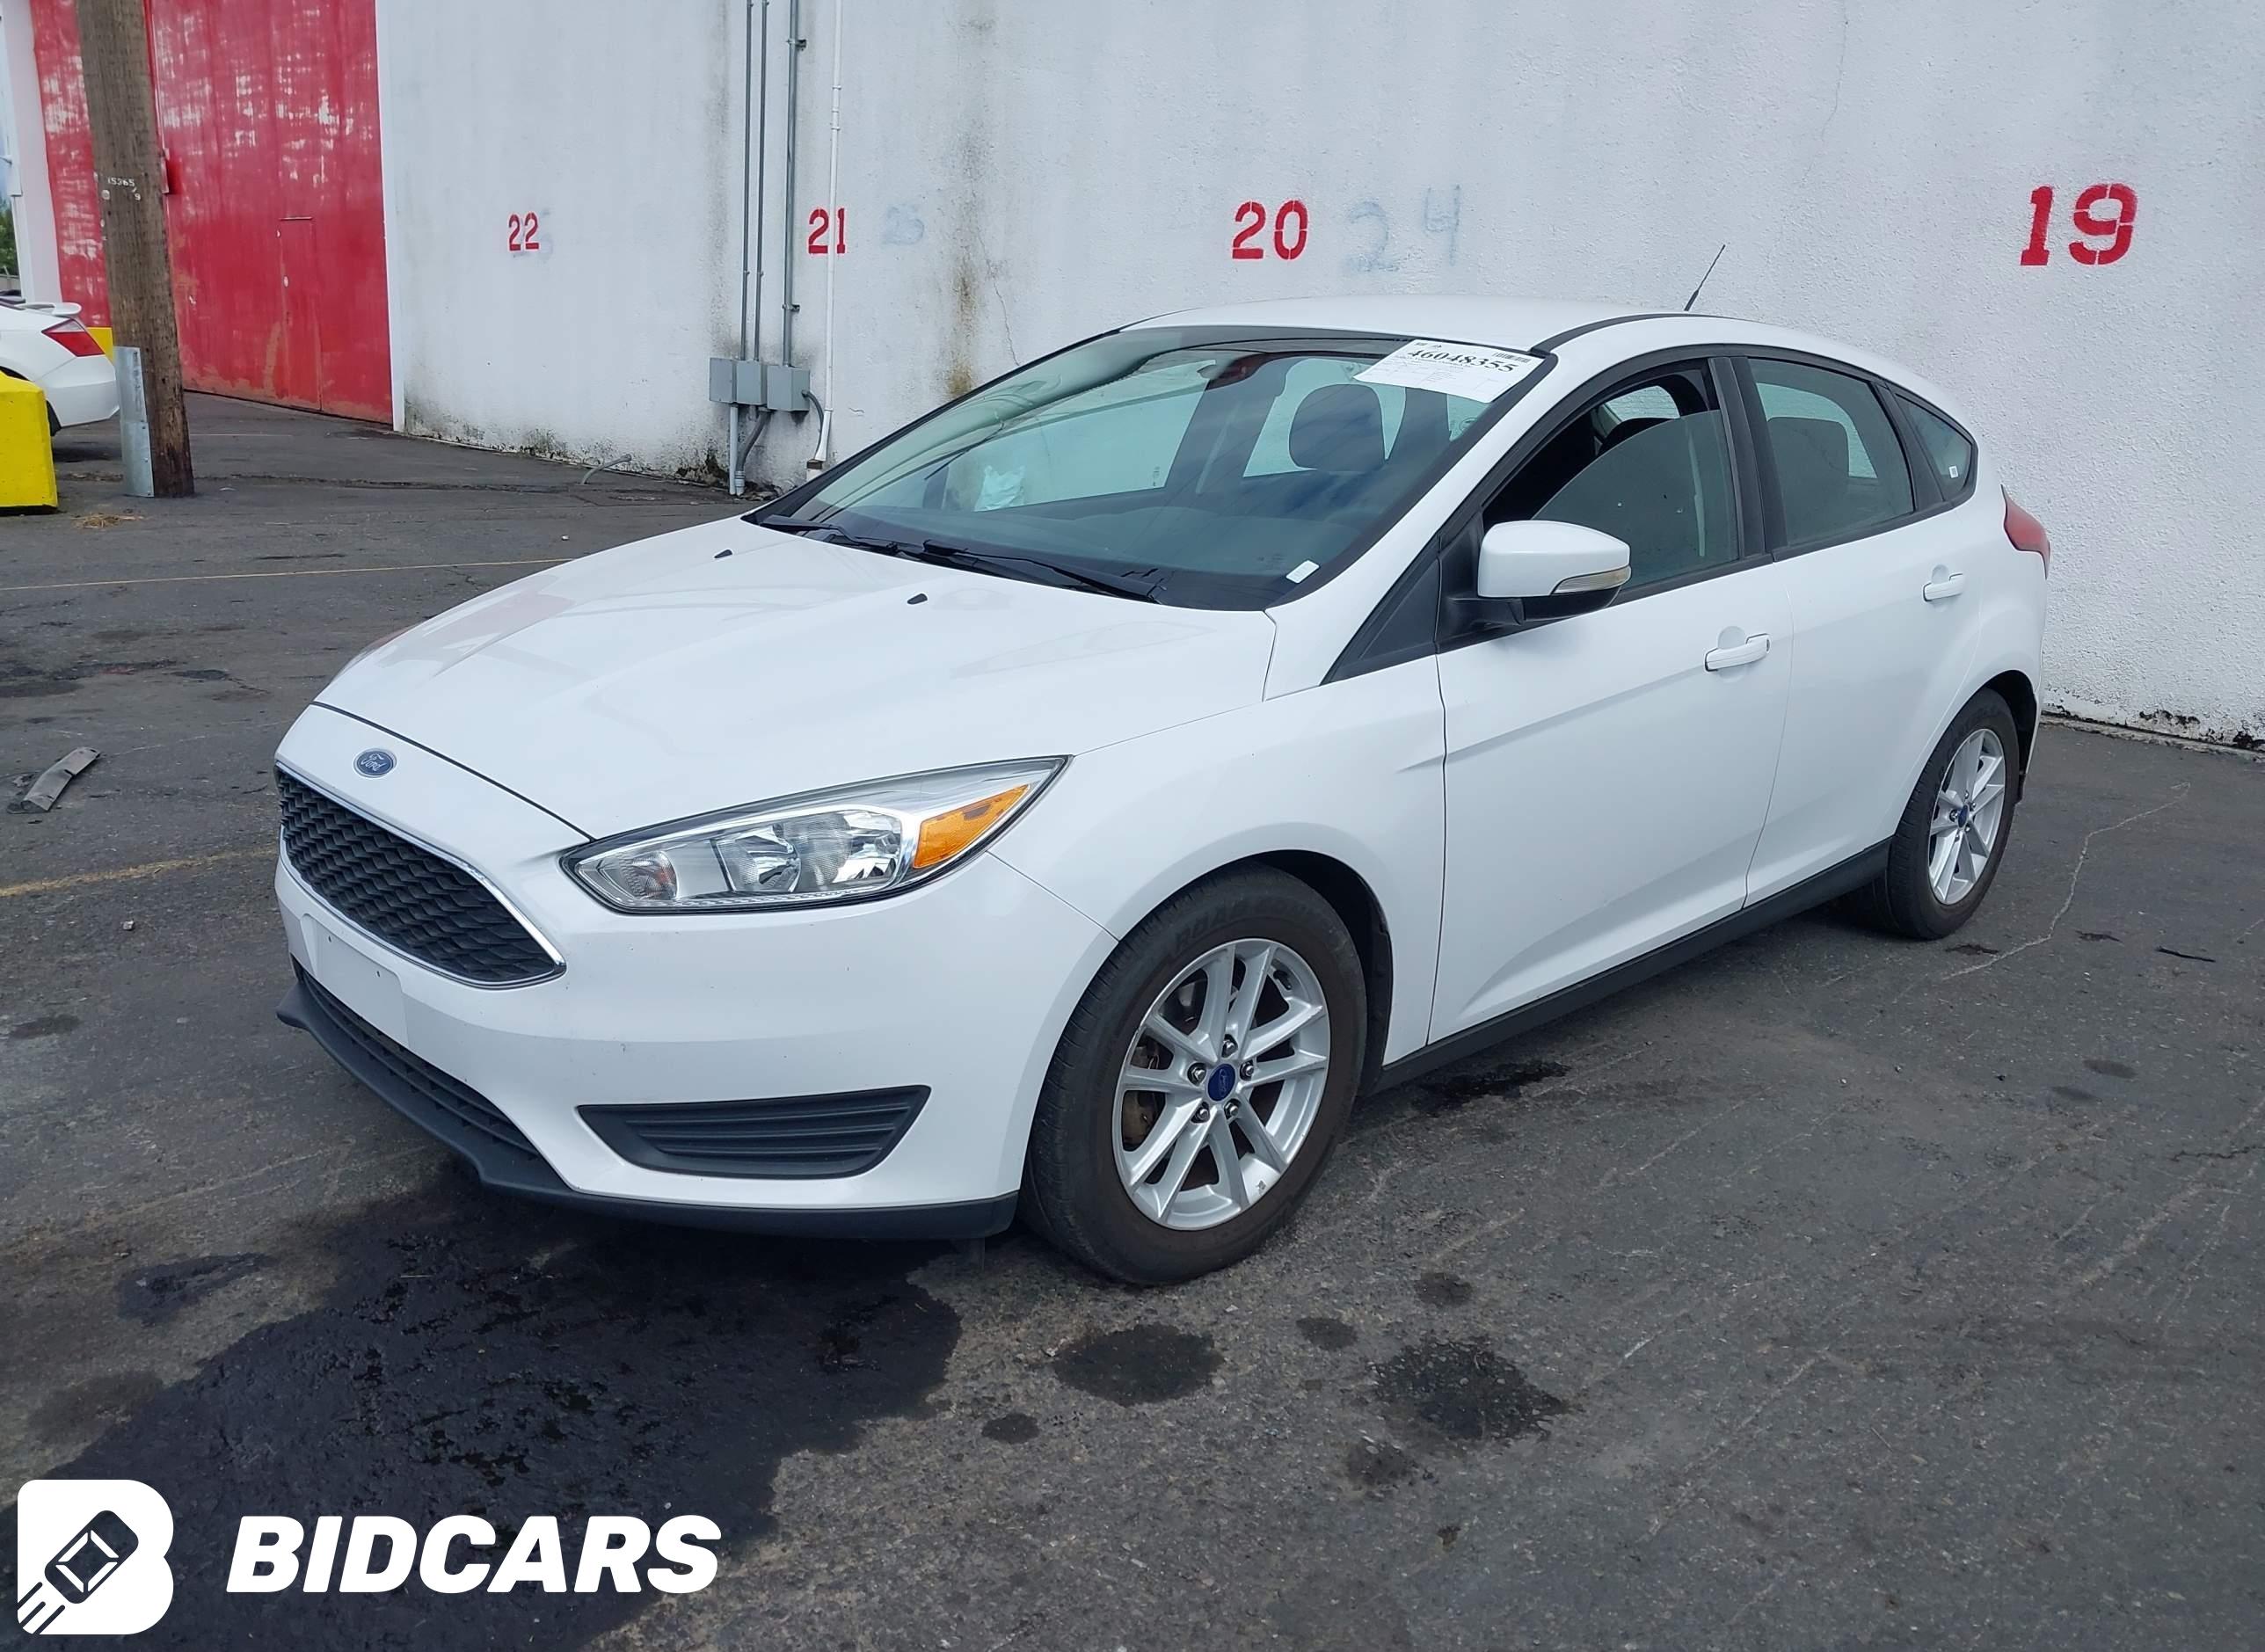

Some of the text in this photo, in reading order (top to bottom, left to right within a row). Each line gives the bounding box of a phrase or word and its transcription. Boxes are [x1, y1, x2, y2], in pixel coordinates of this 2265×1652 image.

[508, 212, 540, 251] 22
[808, 207, 846, 254] 21
[1232, 200, 1308, 260] 20
[2020, 182, 2138, 266] 19
[1407, 349, 1519, 373] 46048355
